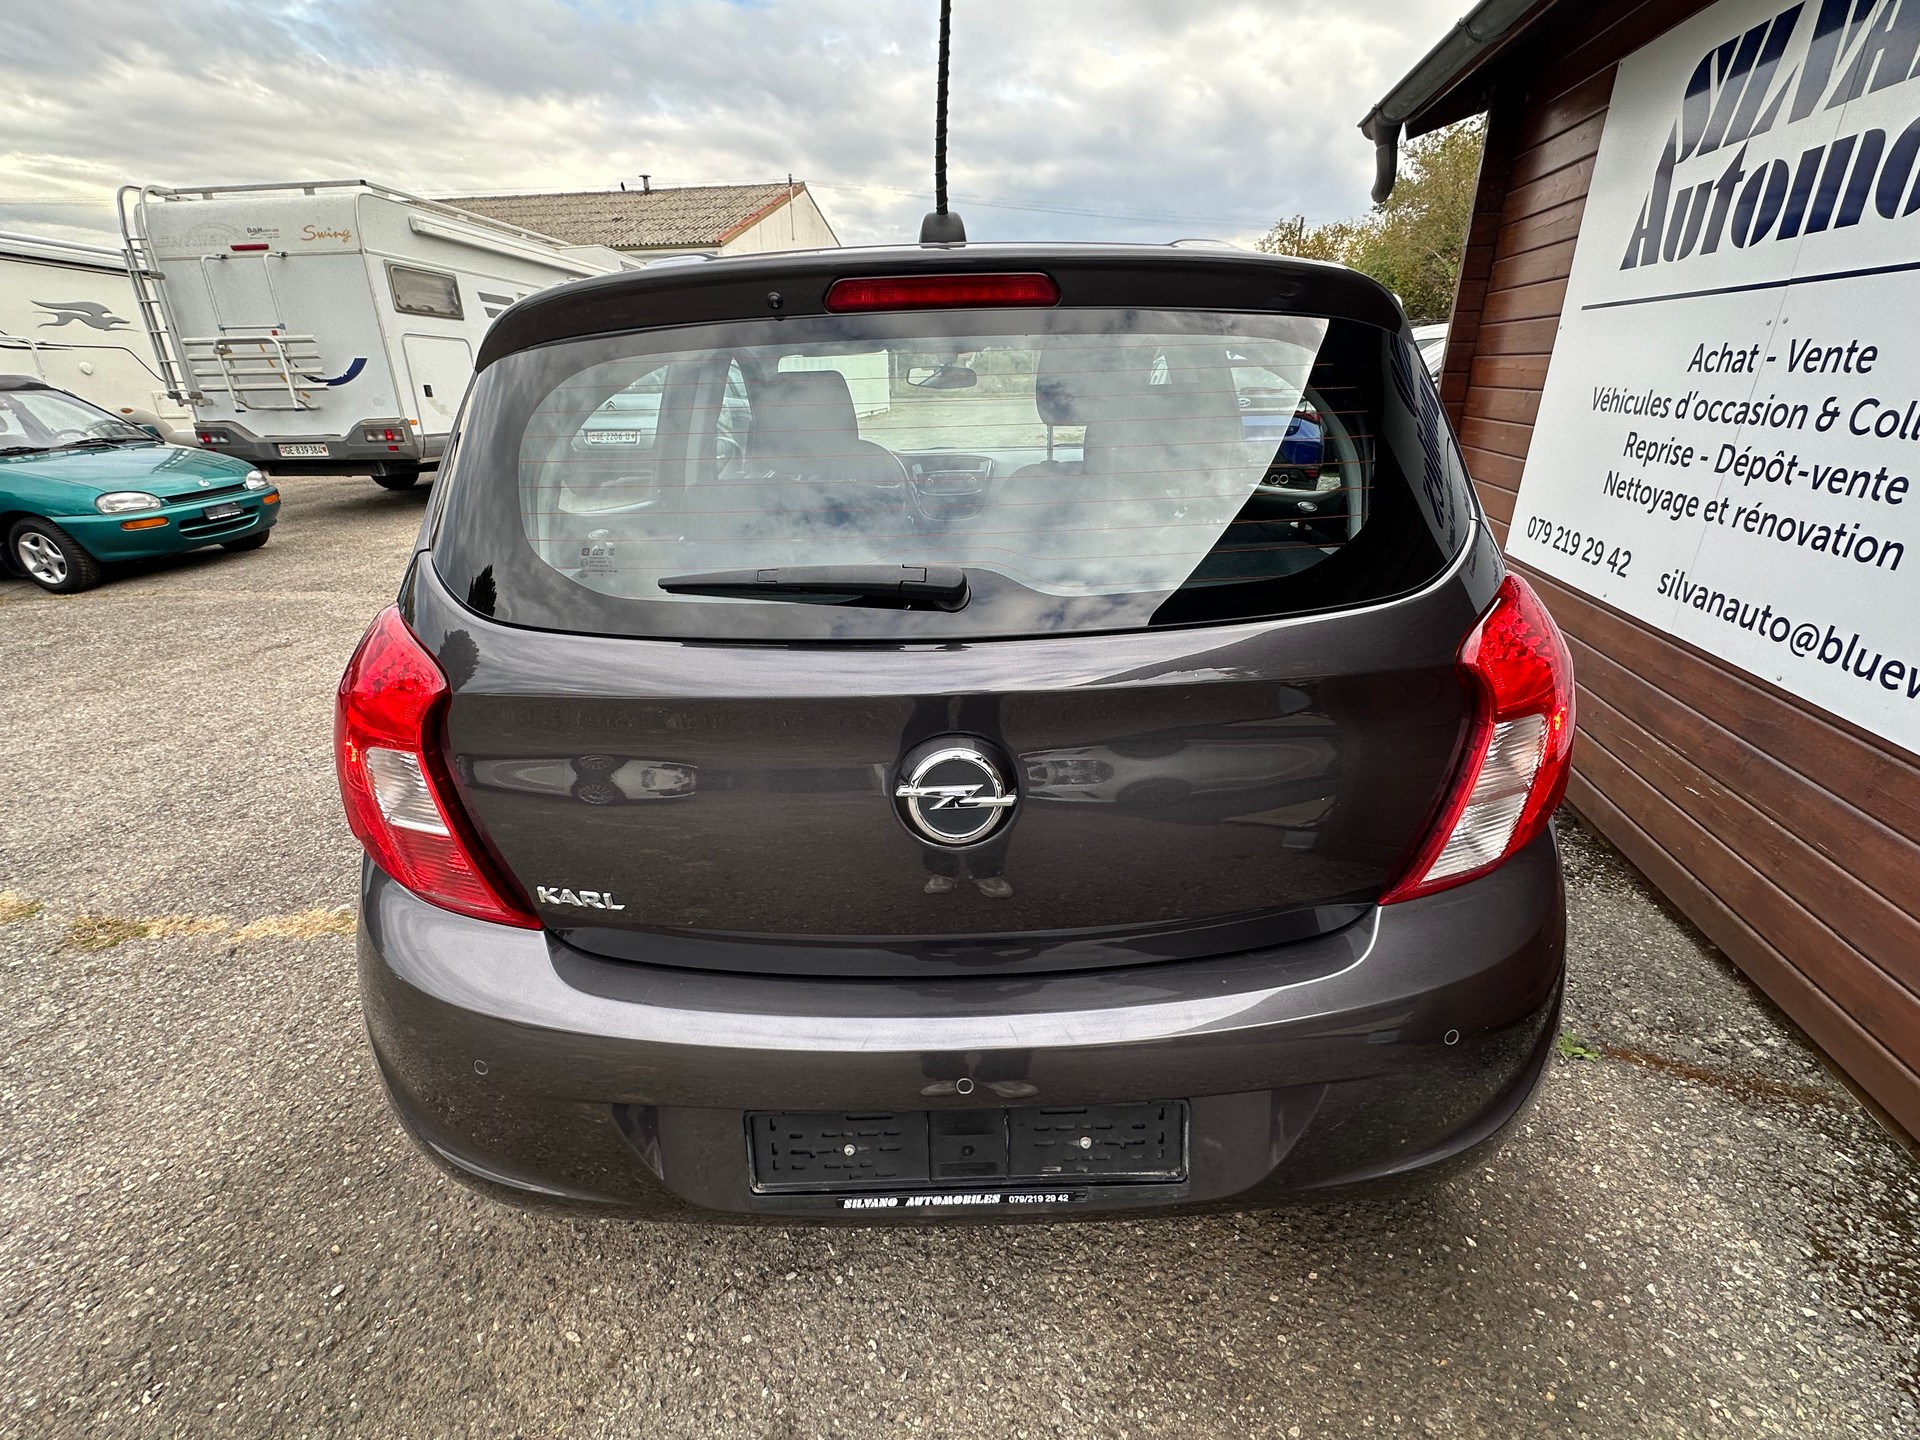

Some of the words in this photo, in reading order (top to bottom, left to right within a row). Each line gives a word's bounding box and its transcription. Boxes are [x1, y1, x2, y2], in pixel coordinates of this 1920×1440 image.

[1674, 0, 1920, 165] SILVA
[301, 224, 351, 243] Swing
[1686, 342, 1760, 374] Achat
[1787, 338, 1878, 374] Vente
[1592, 386, 1672, 419] Véhicules
[1674, 390, 1809, 430] d'occasion
[1814, 396, 1841, 433] &
[1623, 431, 1694, 468] Reprise
[1713, 443, 1910, 505] Dépôt-vente
[1603, 470, 1700, 521] Nettoyage
[1703, 497, 1728, 525] et
[1731, 501, 1905, 572] rénovation
[1527, 515, 1552, 545] 079
[1552, 525, 1581, 556] 219
[1581, 536, 1605, 566] 29
[1606, 547, 1632, 579] 42
[537, 885, 626, 911] KARL
[843, 1197, 898, 1209] SILVANO
[905, 1194, 1001, 1207] AUTOMOBILES
[1008, 1194, 1044, 1204] 079/219
[1045, 1194, 1057, 1203] 29
[1058, 1194, 1069, 1202] 42
